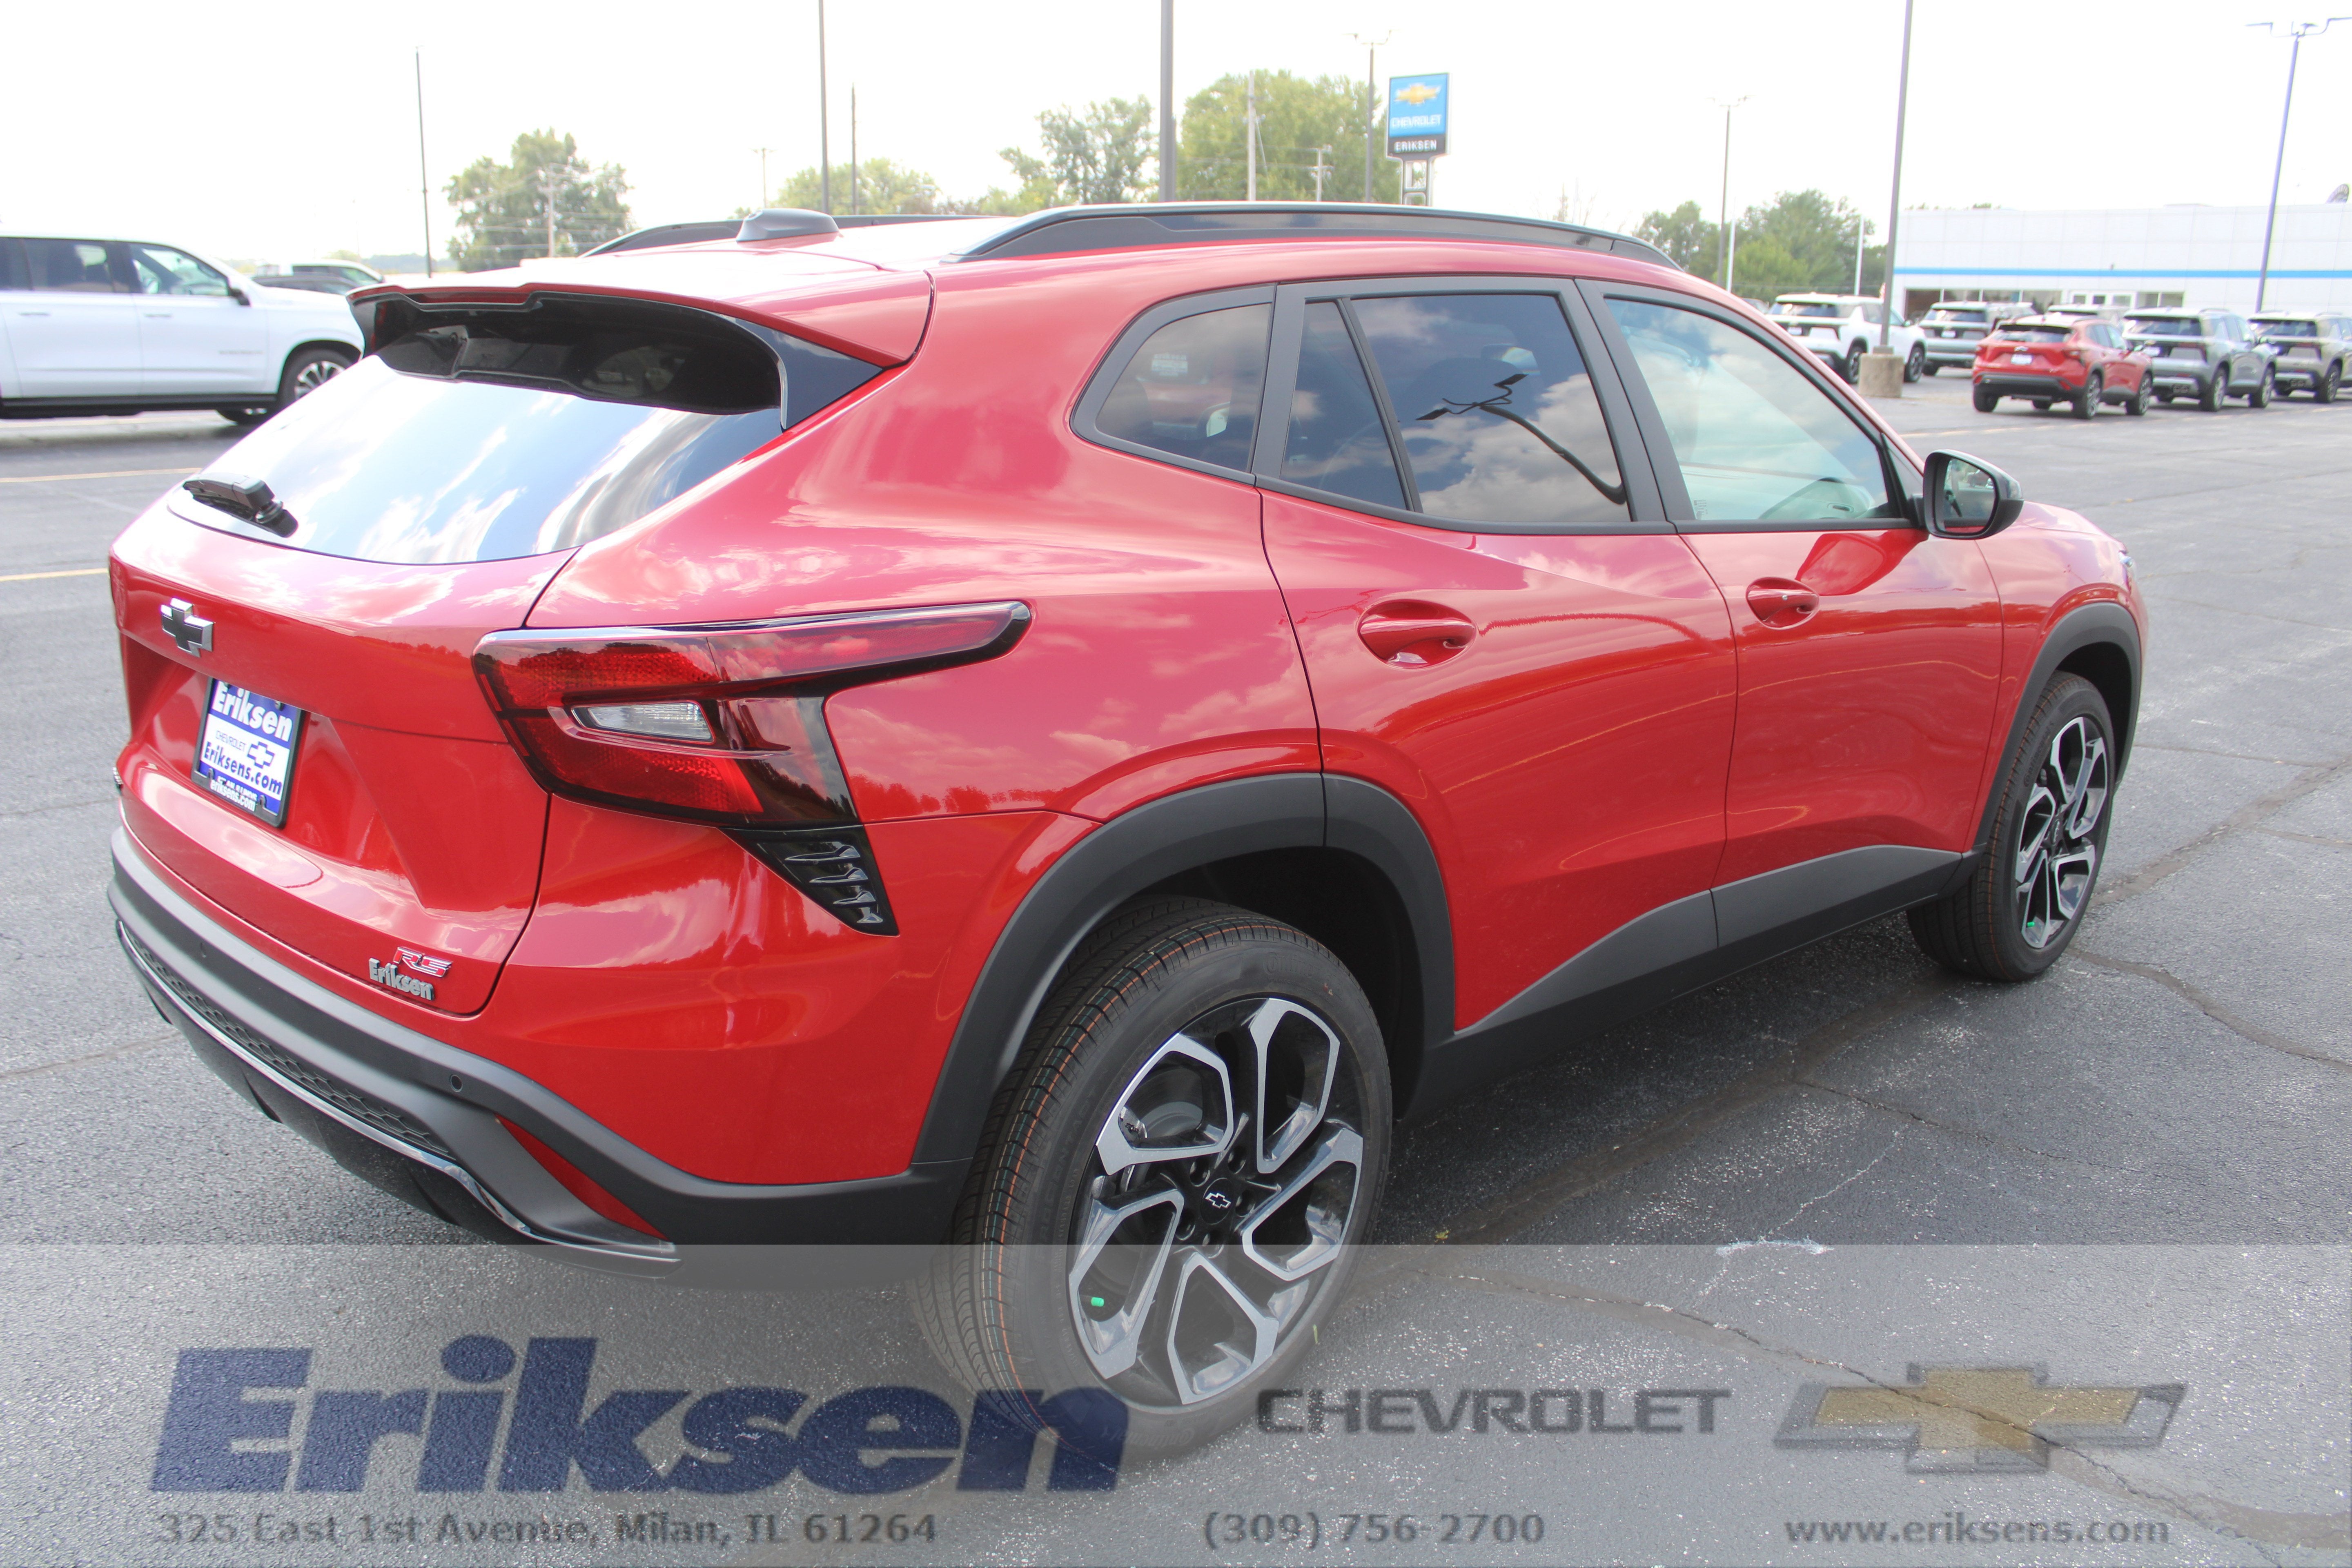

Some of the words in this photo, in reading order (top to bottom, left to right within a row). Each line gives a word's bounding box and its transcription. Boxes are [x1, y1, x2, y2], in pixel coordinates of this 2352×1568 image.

[1391, 114, 1441, 129] CHEVROLET
[1394, 140, 1437, 153] ERIKSEN
[212, 681, 293, 742] Eriksen
[216, 730, 246, 751] CHEVROLET
[204, 741, 282, 795] Eriksens.com
[210, 779, 256, 812] eriksens.com
[393, 946, 453, 978] RS
[368, 957, 436, 1001] Eriksen
